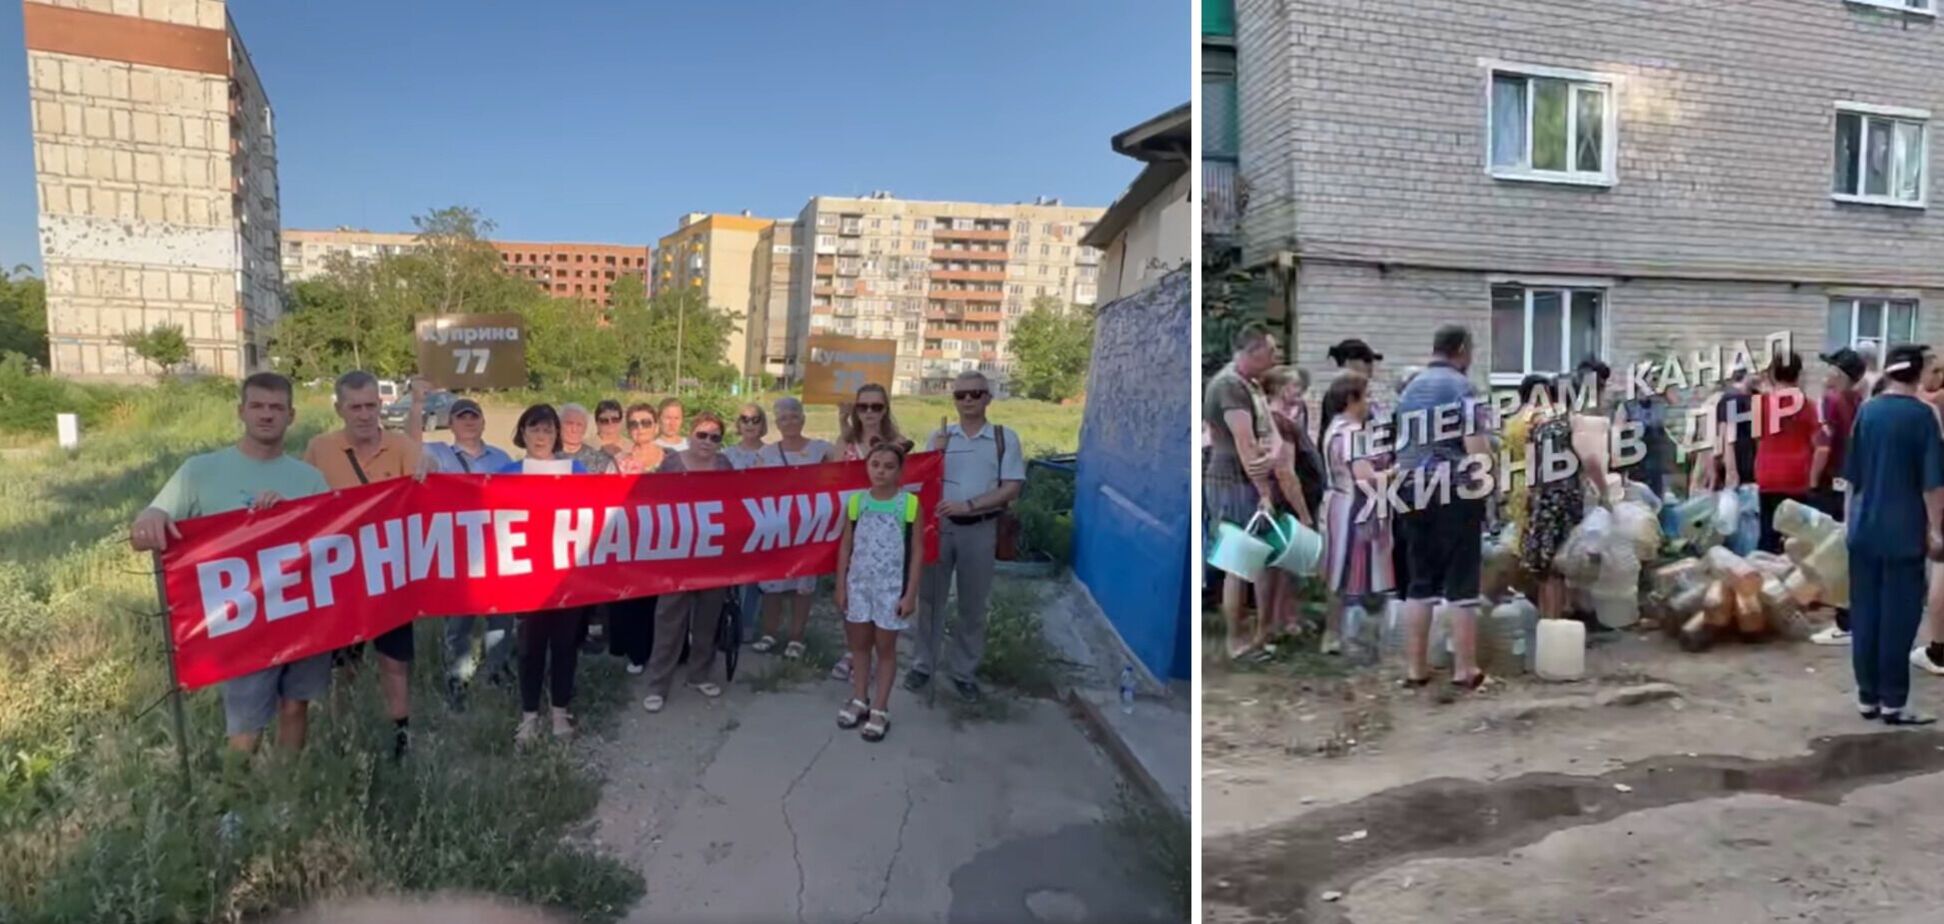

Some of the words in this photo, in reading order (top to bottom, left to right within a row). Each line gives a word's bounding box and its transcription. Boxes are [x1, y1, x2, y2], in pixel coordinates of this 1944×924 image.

[453, 348, 490, 374] 77
[196, 509, 532, 639] ВЕРНИТЕ
[552, 500, 725, 570] НАШЕ
[742, 482, 924, 554] ЖИЛ
